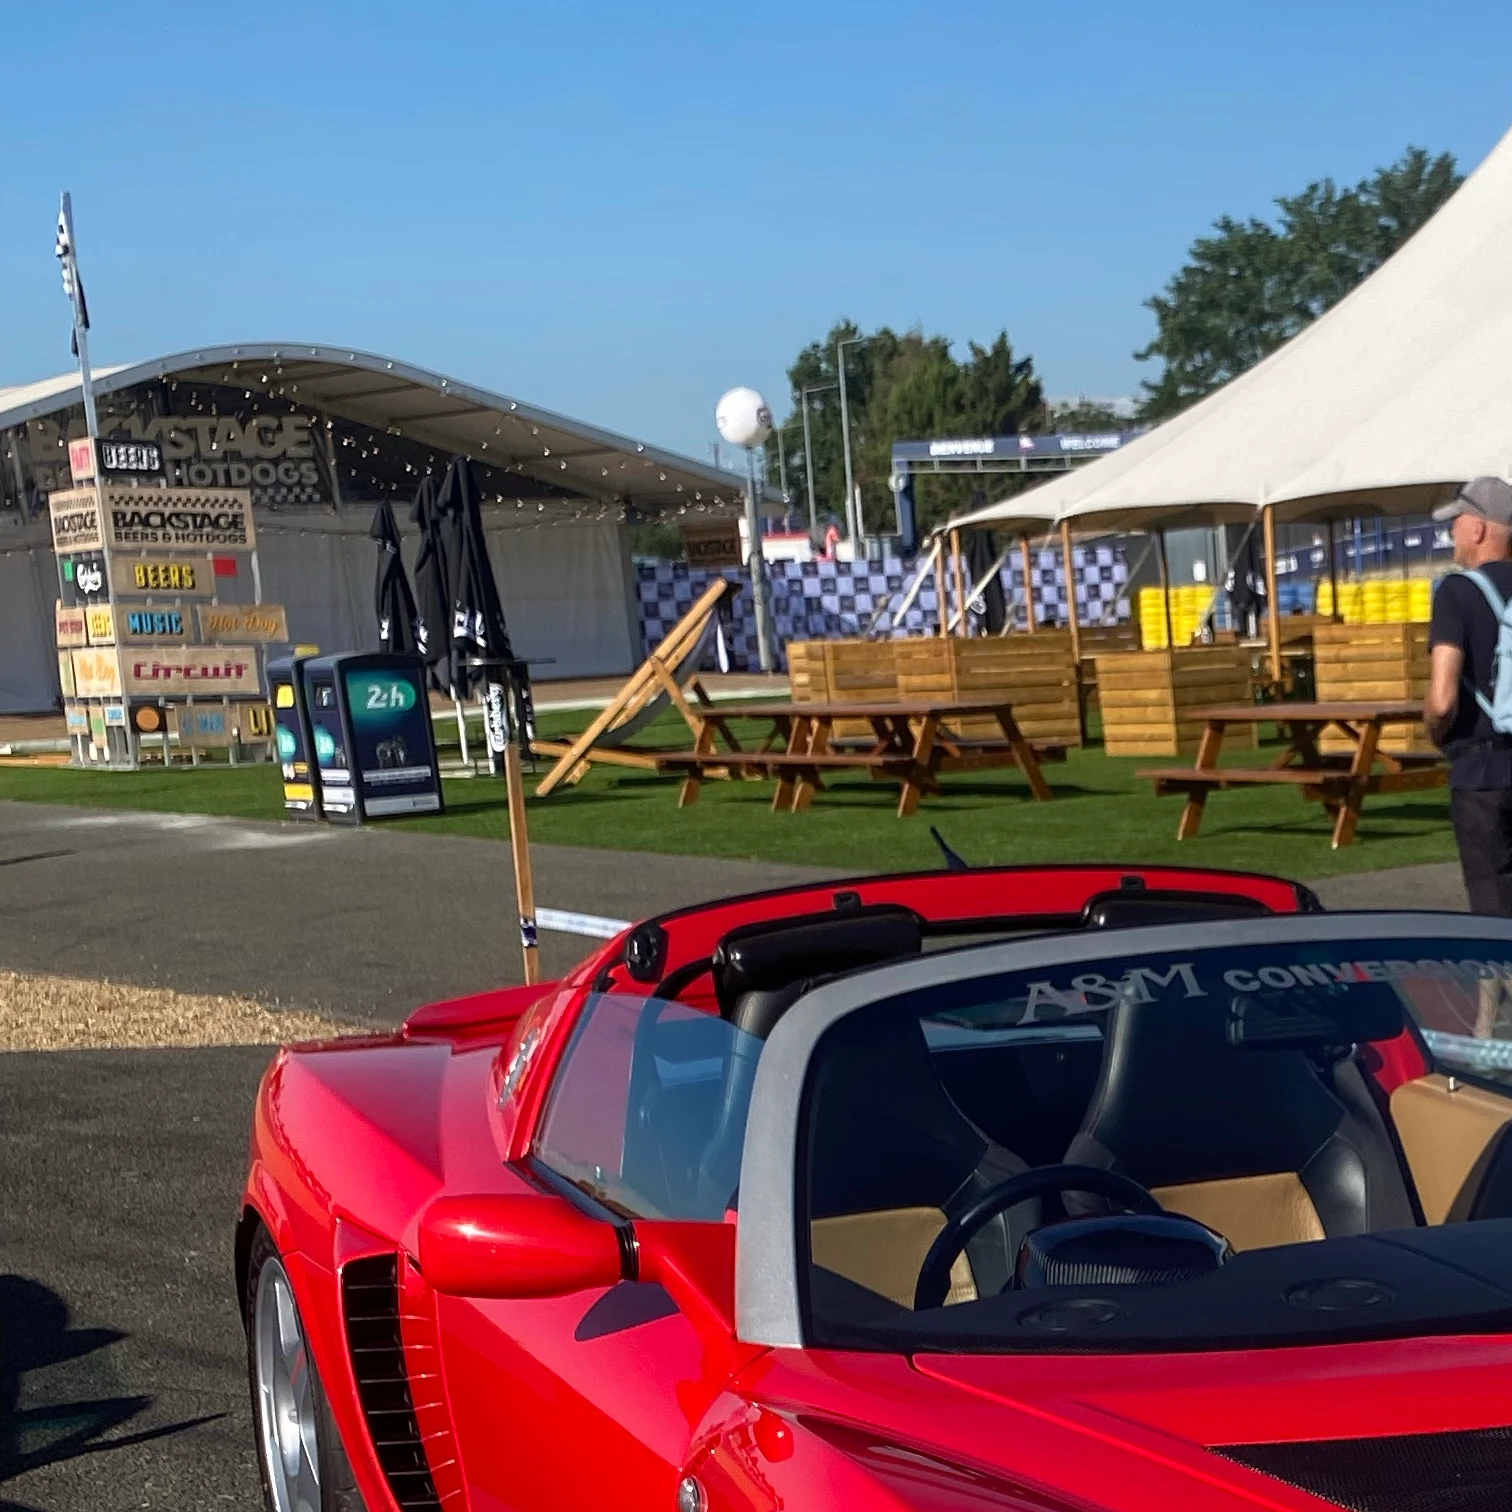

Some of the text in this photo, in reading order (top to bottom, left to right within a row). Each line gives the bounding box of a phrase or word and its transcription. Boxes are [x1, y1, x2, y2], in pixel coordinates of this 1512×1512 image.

[112, 511, 245, 530] BACKSTAGE
[114, 531, 158, 543] BEERS
[175, 533, 247, 544] HOTDOGS
[134, 563, 195, 590] BEERS
[127, 610, 184, 636] MUSIC
[133, 661, 249, 681] Circuit
[1016, 963, 1209, 1026] A&M
